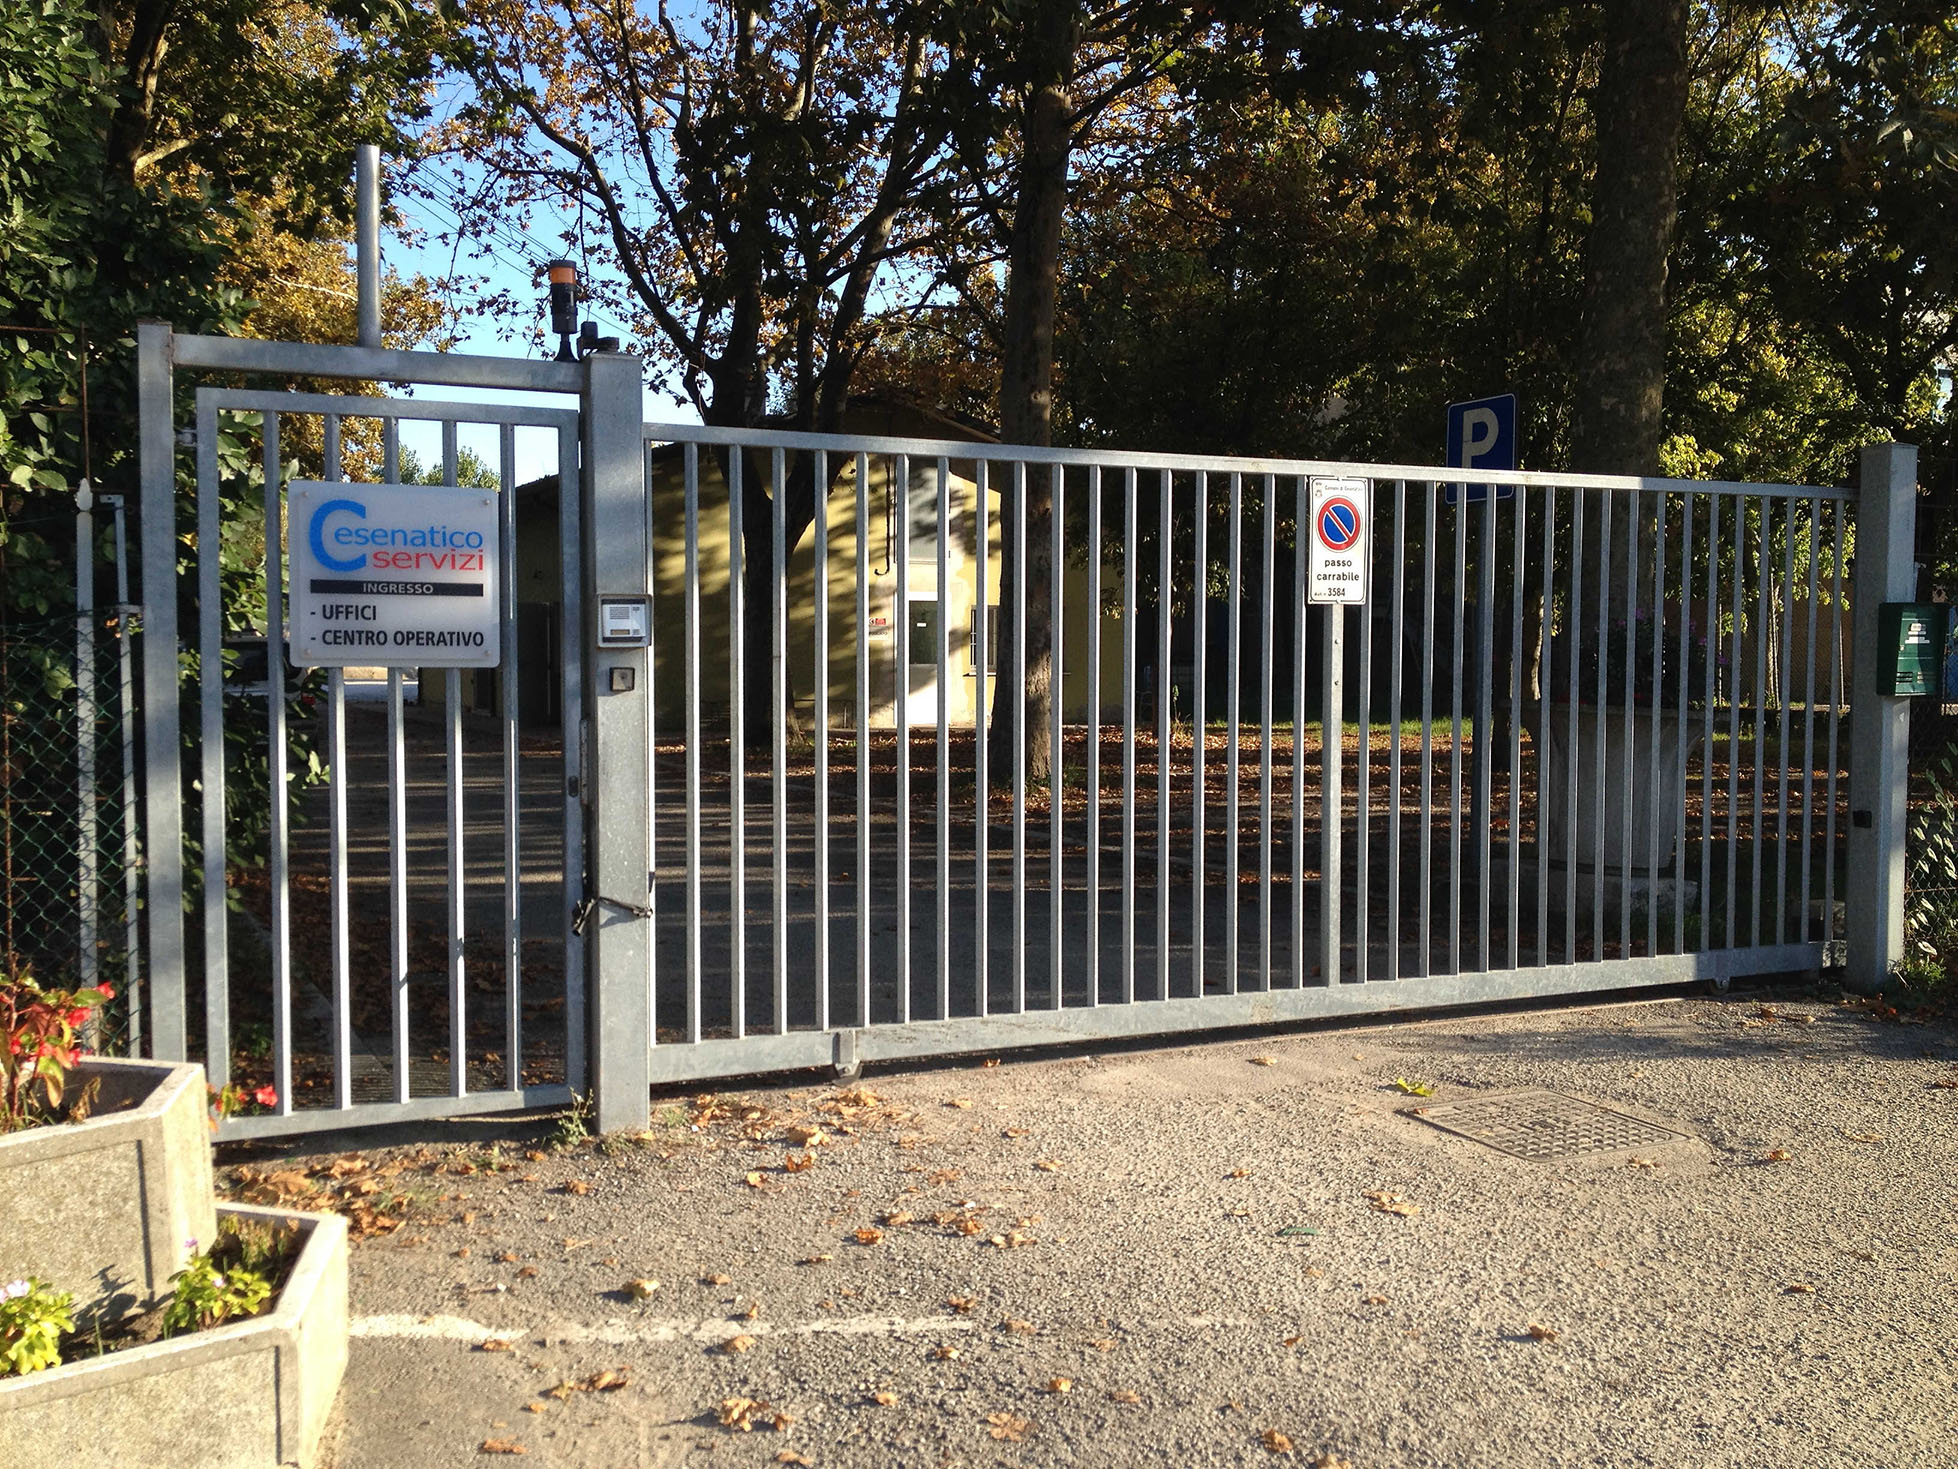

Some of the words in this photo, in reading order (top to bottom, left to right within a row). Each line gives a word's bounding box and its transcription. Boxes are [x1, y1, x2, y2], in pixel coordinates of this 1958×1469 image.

[1462, 407, 1499, 469] P
[309, 499, 483, 573] Cesenatico
[372, 548, 484, 571] servizi
[1324, 559, 1353, 568] passo
[1316, 572, 1360, 581] carrabile
[362, 582, 434, 595] INGRESSO
[1327, 587, 1346, 597] 3584
[322, 604, 377, 621] UFFICI
[322, 629, 388, 647] CENTRO
[393, 630, 485, 648] OPERATIVO
